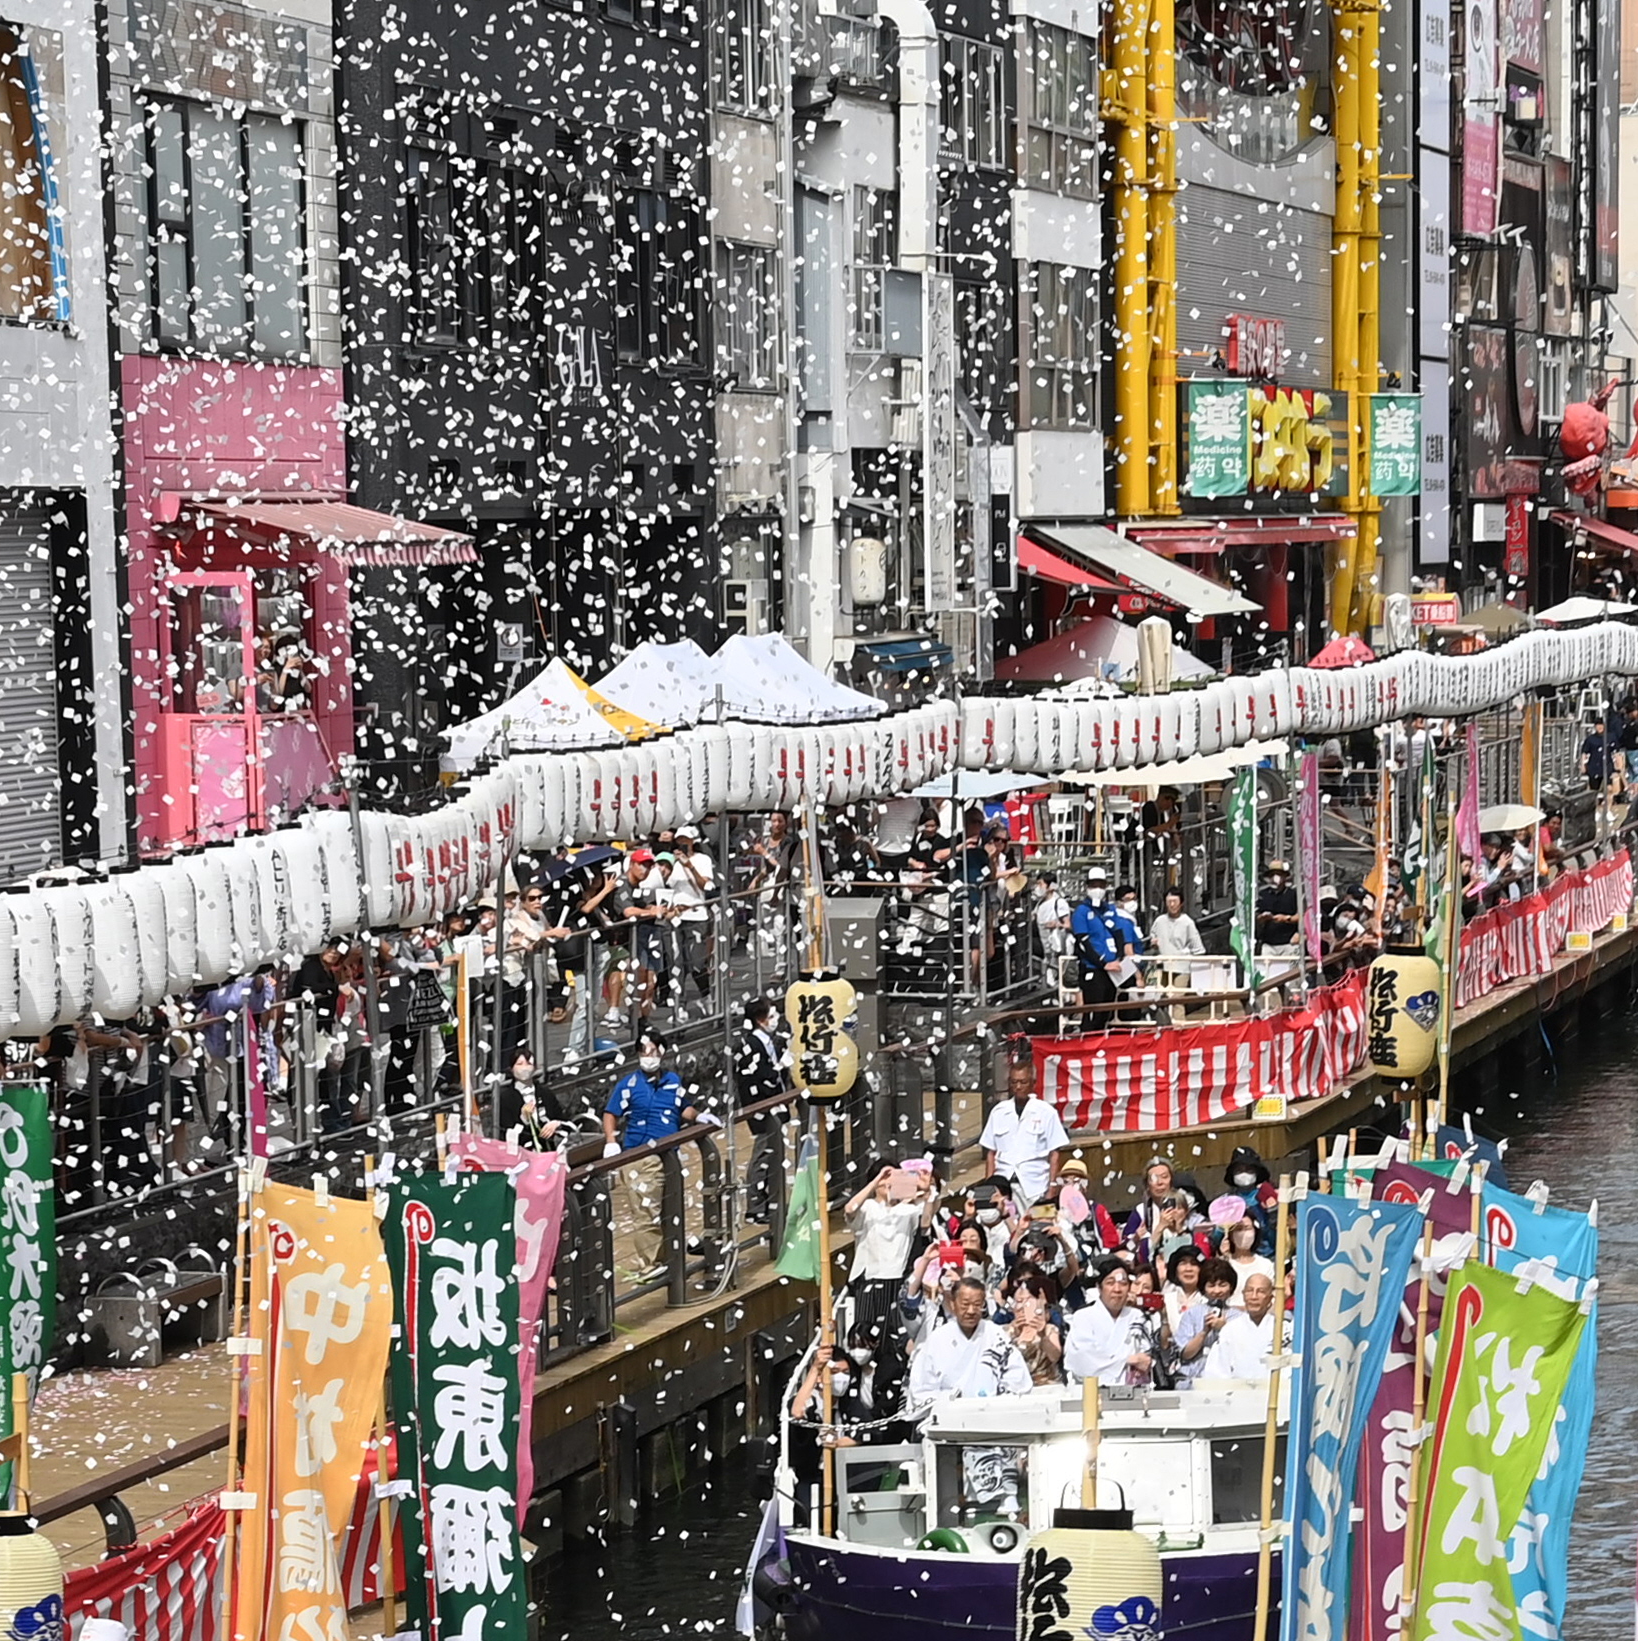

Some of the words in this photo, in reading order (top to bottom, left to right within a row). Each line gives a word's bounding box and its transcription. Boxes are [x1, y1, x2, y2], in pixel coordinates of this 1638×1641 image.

[1194, 395, 1243, 442] 薬
[1374, 408, 1416, 449] 薬
[1194, 446, 1243, 454] Medicine
[1368, 965, 1398, 1068] 松竹座
[798, 995, 838, 1087] 松竹座
